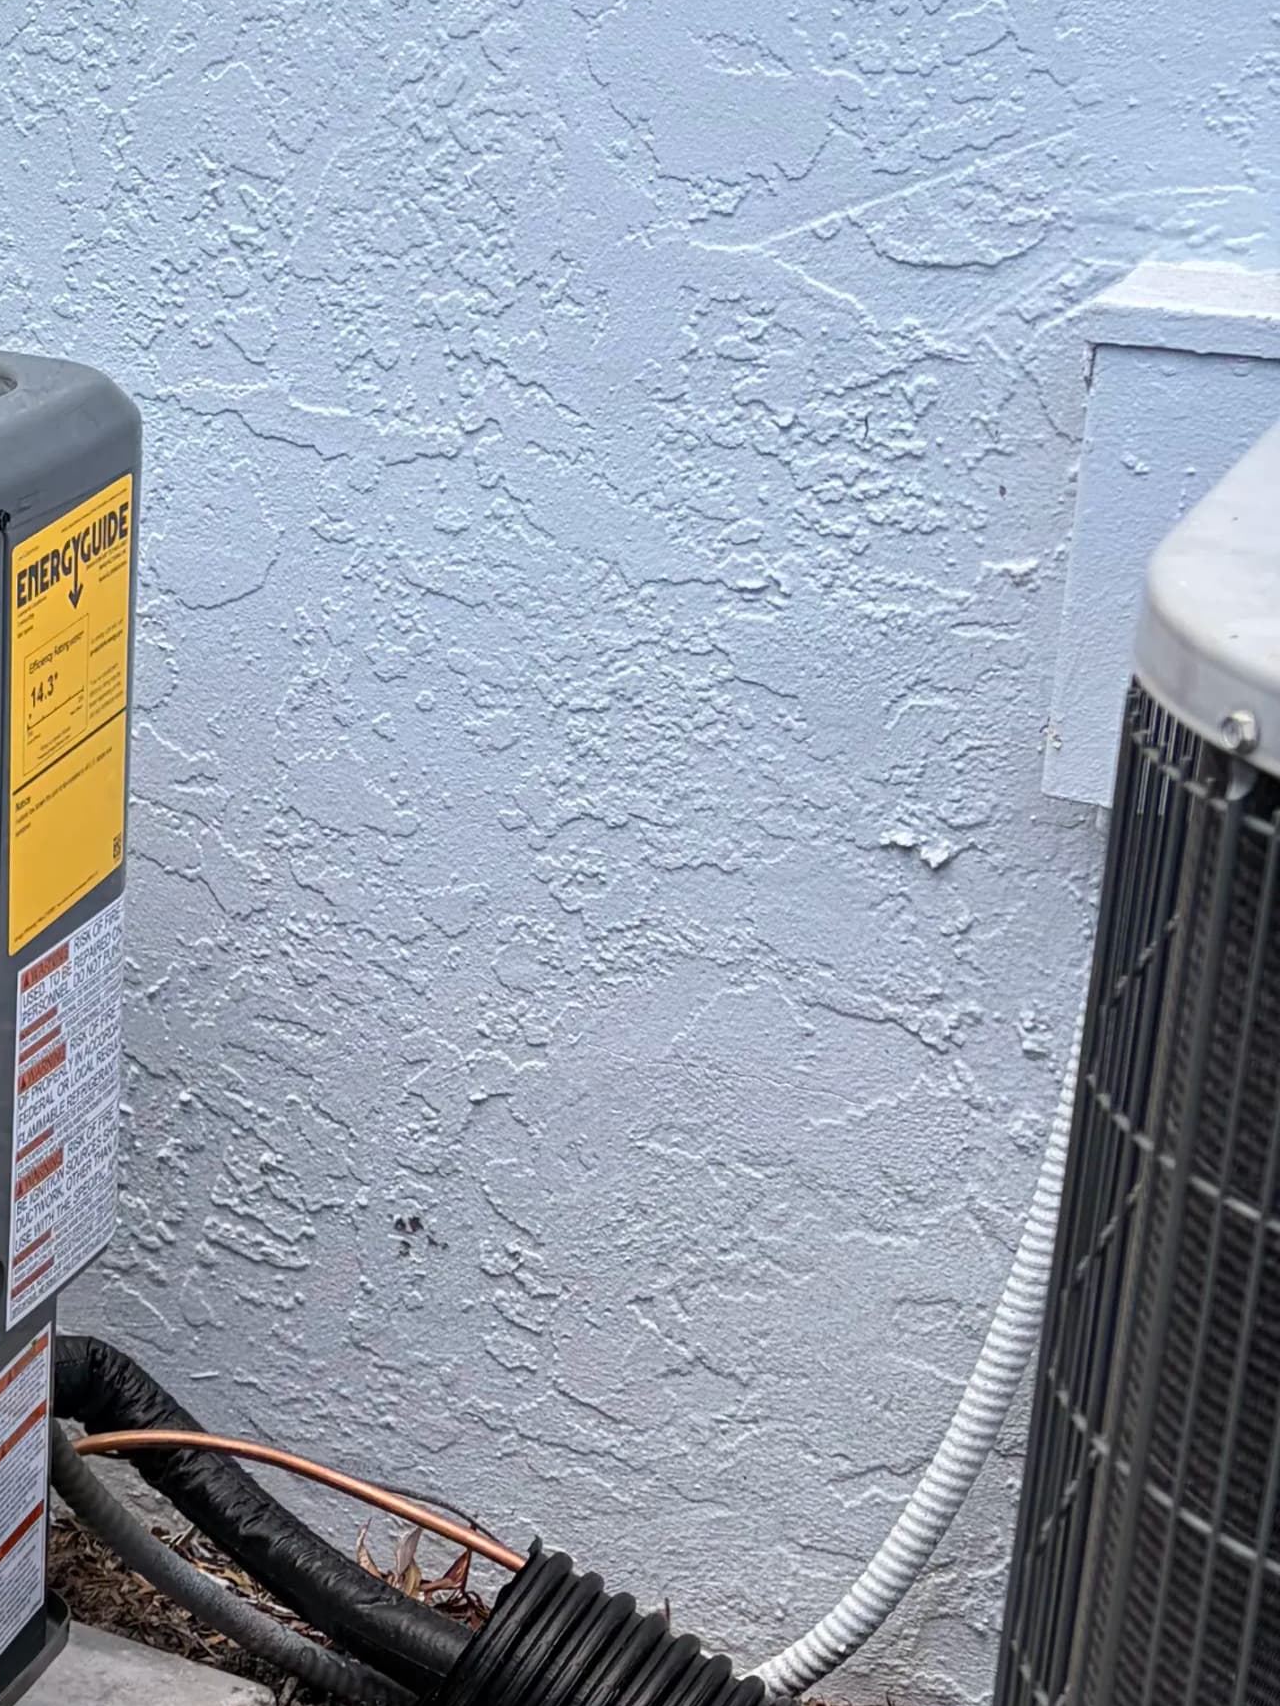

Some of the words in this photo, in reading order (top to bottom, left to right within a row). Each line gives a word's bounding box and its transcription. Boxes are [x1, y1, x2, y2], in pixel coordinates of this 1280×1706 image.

[17, 502, 129, 609] ENERGYGUIDE
[49, 972, 60, 989] TO
[62, 963, 71, 979] BE
[74, 933, 110, 970] REPAIRED
[74, 929, 91, 951] RISK
[92, 920, 103, 937] OF
[73, 970, 84, 987] DO
[86, 957, 101, 978] NOT
[69, 1029, 87, 1052] RISK
[89, 1020, 99, 1037] OF
[18, 1093, 29, 1110] OF
[31, 1059, 73, 1099] PROPERLY
[74, 1050, 83, 1066] IN
[18, 1090, 54, 1128] FEDERAL
[57, 1079, 69, 1097] OR
[70, 1059, 94, 1086] LOCAL
[17, 1102, 64, 1148] FLAMMABLE
[67, 1133, 84, 1156] RISK
[86, 1123, 96, 1139] OF
[16, 1199, 28, 1215] BE
[29, 1169, 63, 1205] IGNITION
[65, 1136, 101, 1175] SOURCES
[66, 1161, 91, 1192] OTHER
[94, 1143, 112, 1166] THAN
[15, 1230, 32, 1252] USE
[34, 1212, 54, 1236] WITH
[56, 1197, 71, 1217] THE
